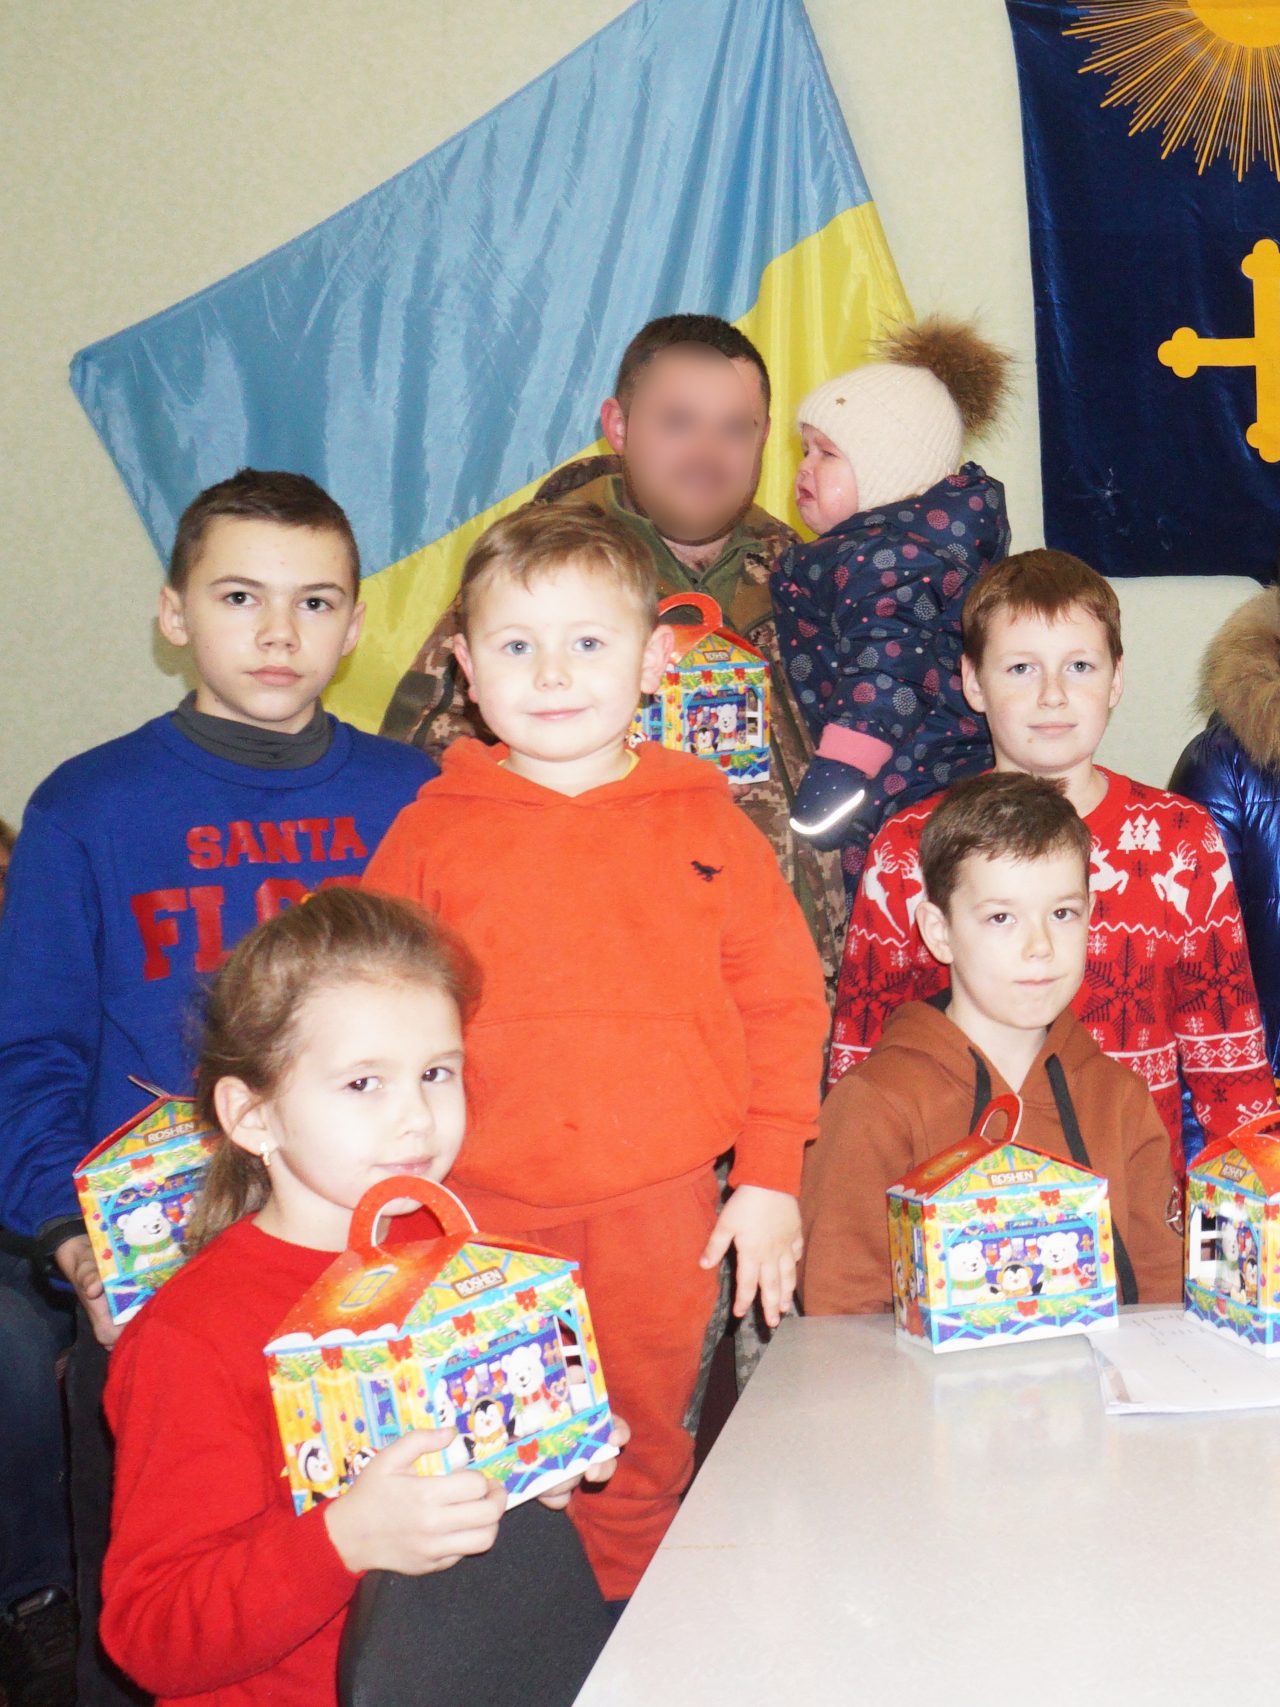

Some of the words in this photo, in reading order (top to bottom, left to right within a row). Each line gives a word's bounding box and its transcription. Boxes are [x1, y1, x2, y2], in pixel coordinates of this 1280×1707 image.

[185, 816, 368, 870] SANTA
[130, 875, 362, 982] FLO
[147, 1121, 196, 1144] ROSHEN
[990, 1170, 1034, 1186] ROSHEN
[455, 1269, 503, 1297] ROSHEN
